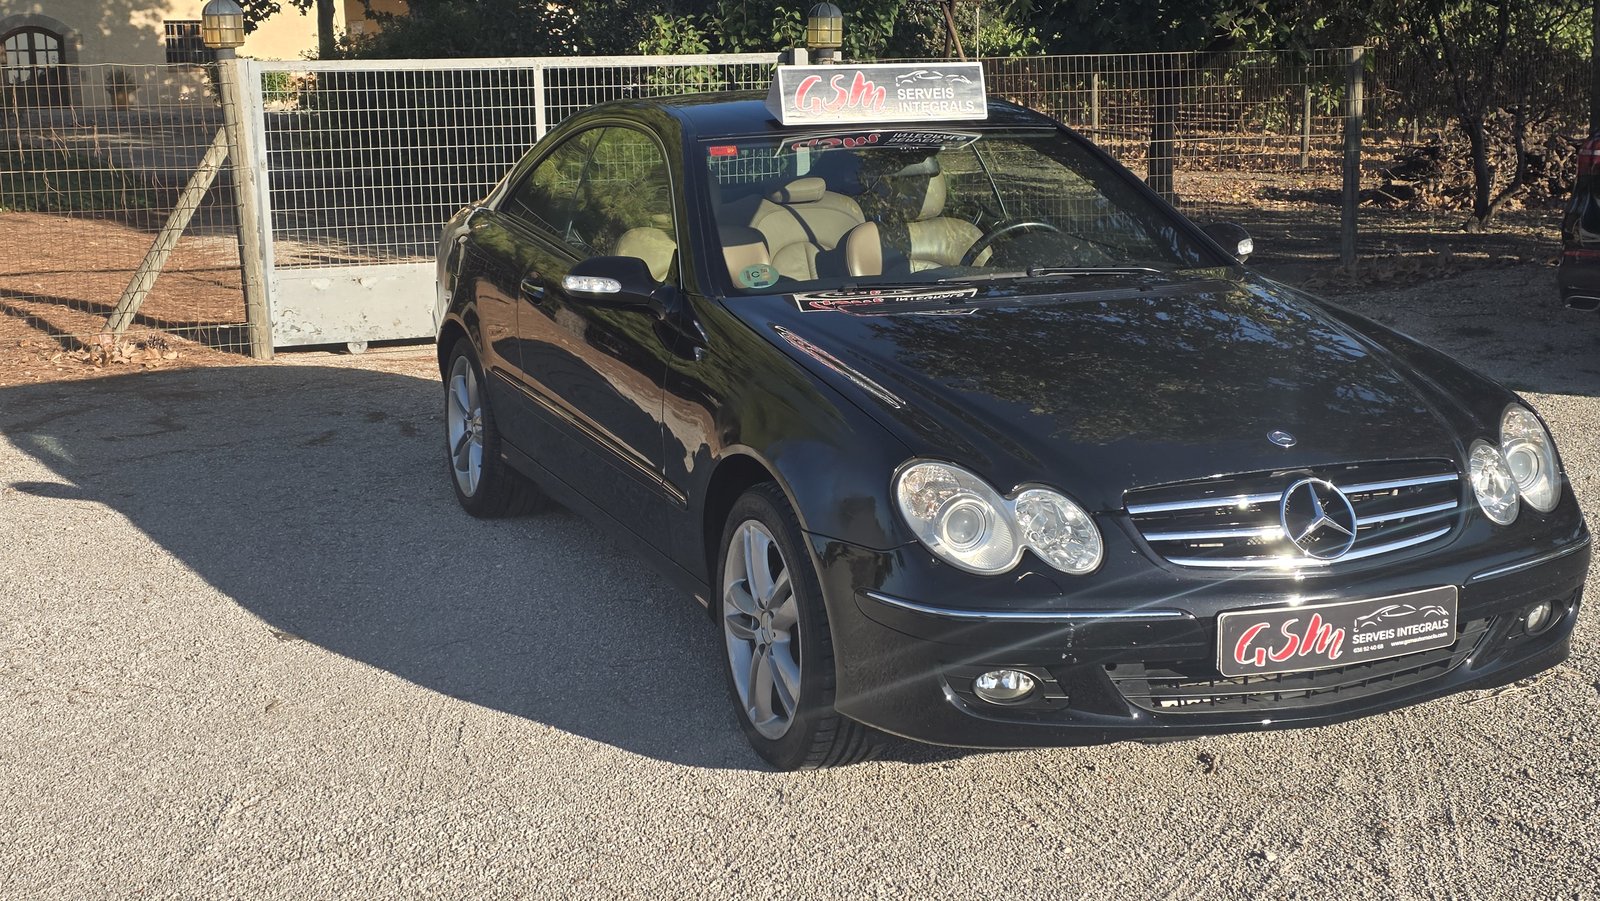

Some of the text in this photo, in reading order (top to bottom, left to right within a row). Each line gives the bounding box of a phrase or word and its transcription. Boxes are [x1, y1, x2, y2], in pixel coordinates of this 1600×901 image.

[794, 71, 887, 115] GSM
[897, 87, 955, 100] SERVEIS
[898, 100, 975, 113] INTEGRALS
[1233, 612, 1346, 666] GSM
[1352, 618, 1449, 645] SERVEIS INTEGRALS
